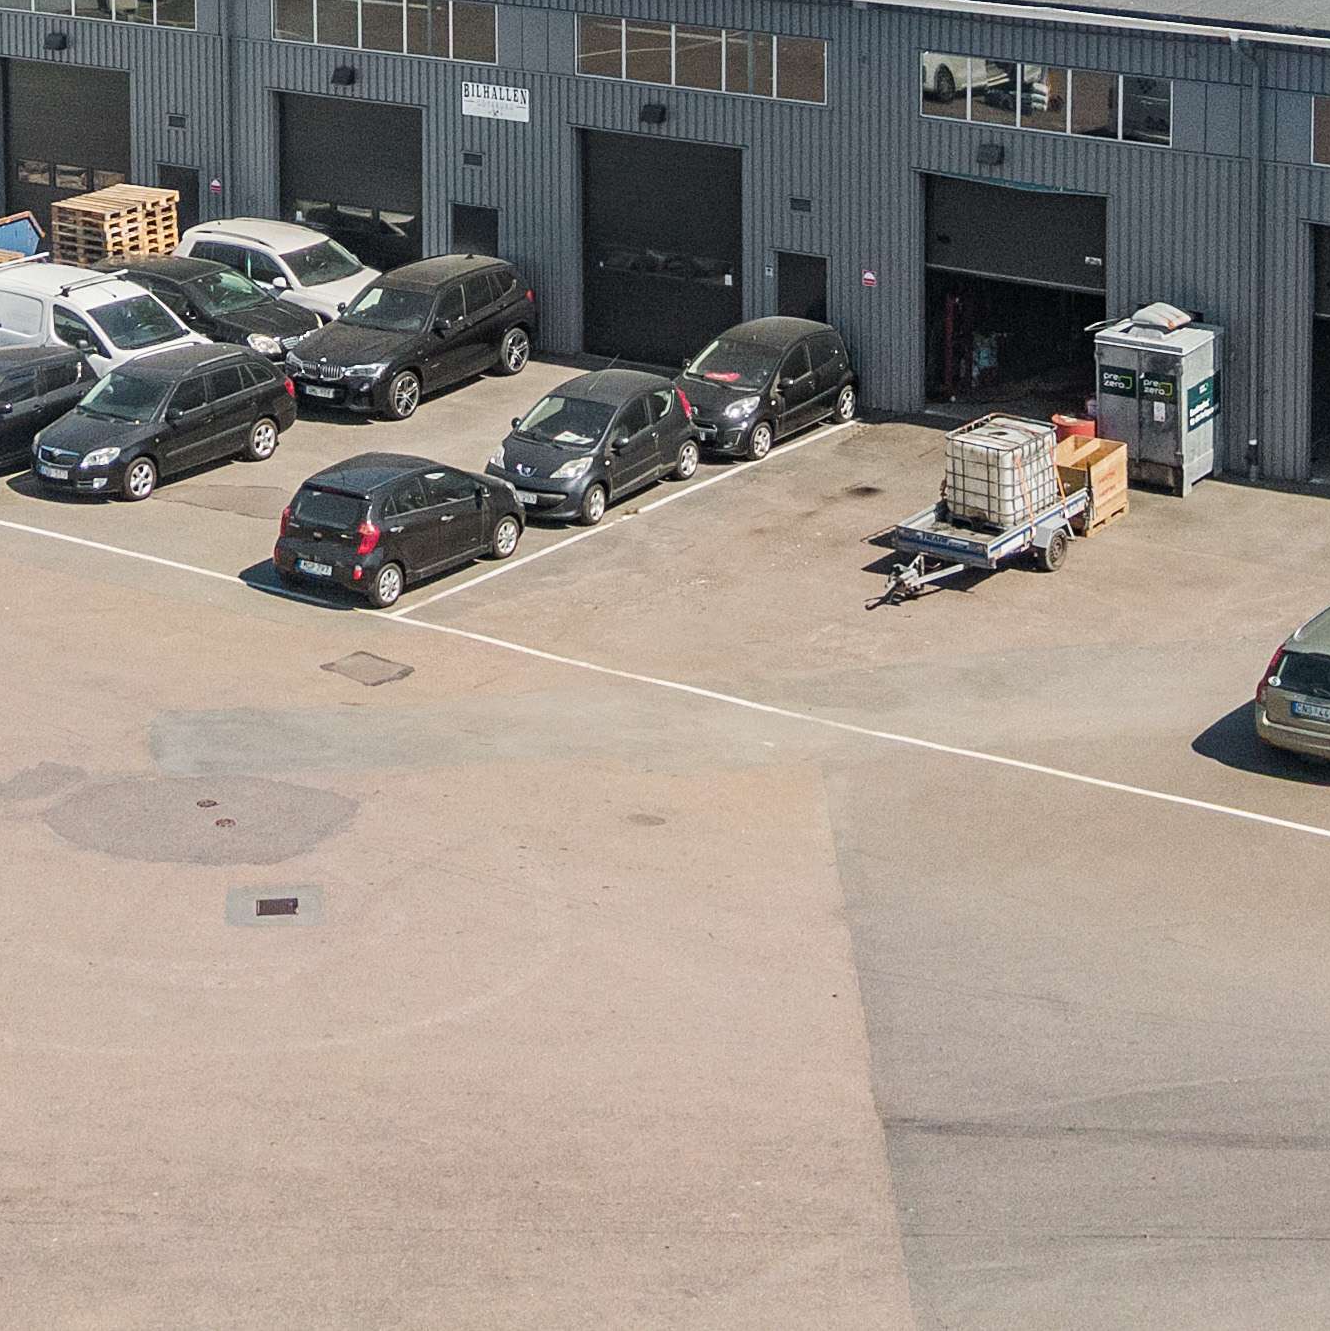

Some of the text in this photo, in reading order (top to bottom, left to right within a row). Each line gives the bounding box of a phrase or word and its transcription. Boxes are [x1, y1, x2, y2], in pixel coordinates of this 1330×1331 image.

[464, 83, 527, 104] BILHALLEN
[1103, 372, 1118, 381] pre
[1103, 381, 1125, 389] zero
[1143, 379, 1159, 387] pre
